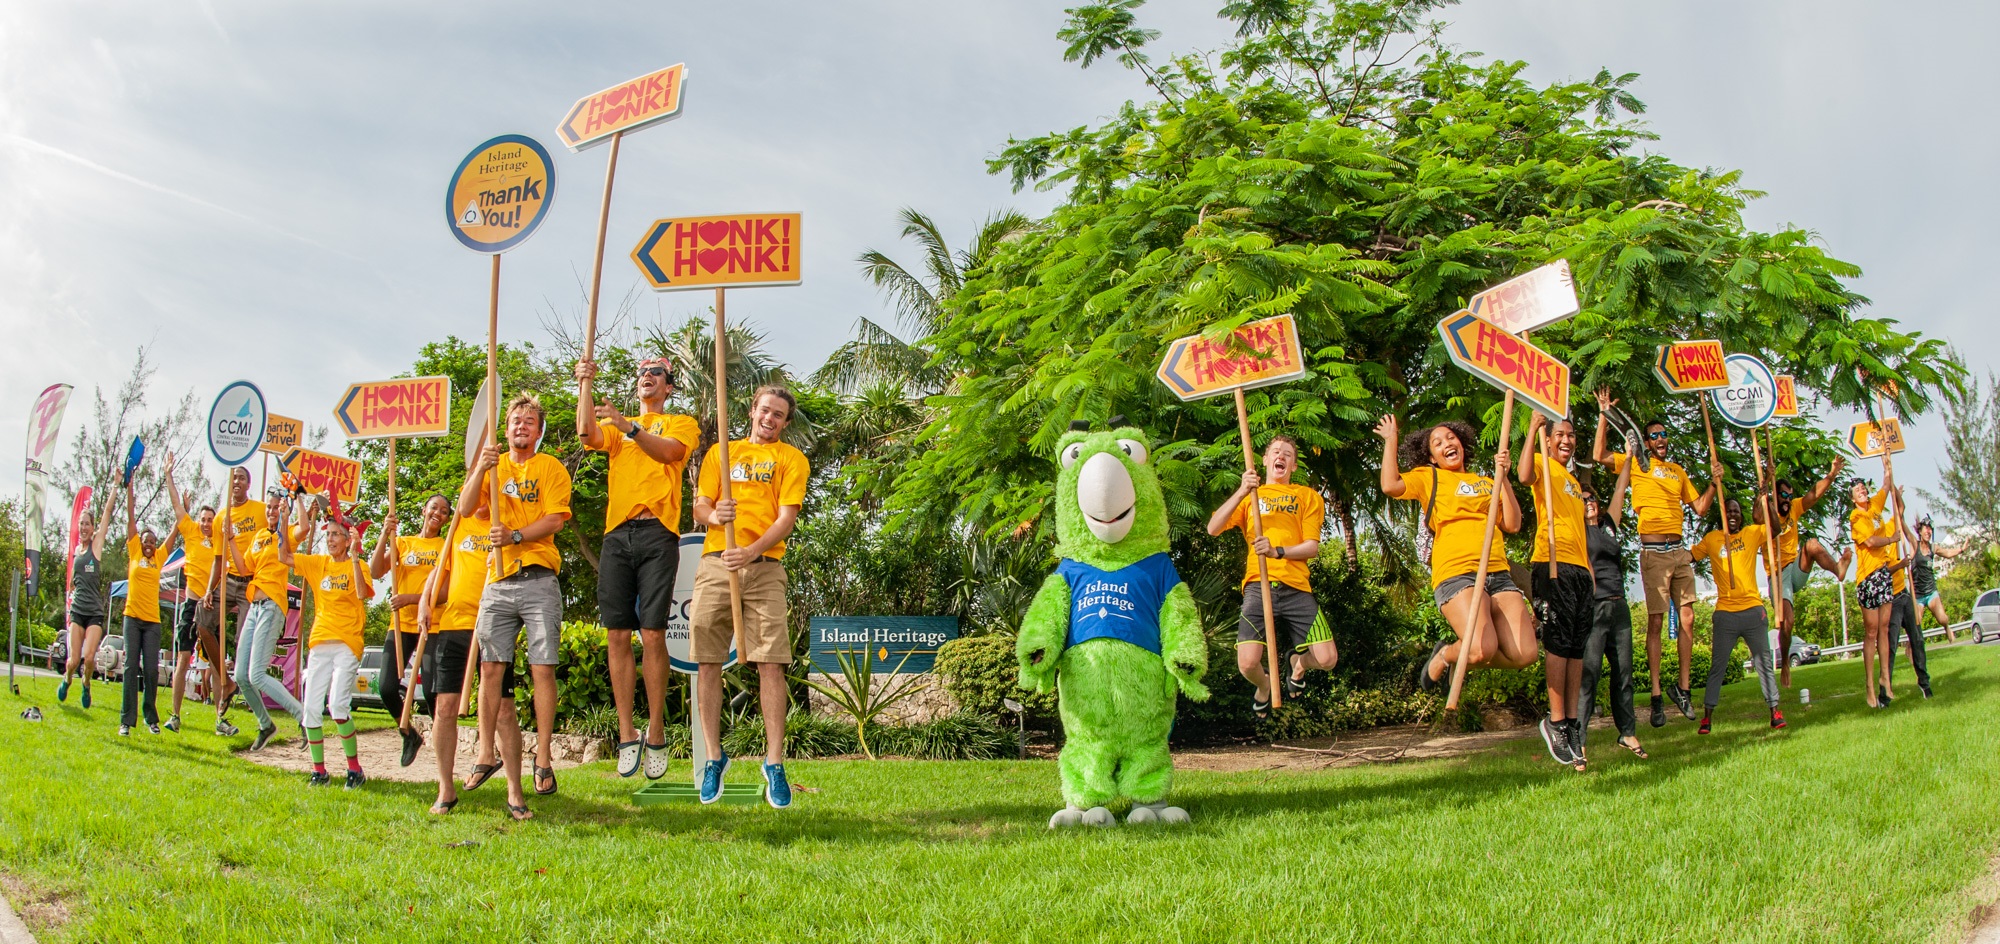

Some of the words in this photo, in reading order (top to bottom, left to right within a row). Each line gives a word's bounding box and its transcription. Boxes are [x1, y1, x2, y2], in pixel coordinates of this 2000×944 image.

[487, 147, 522, 163] Island
[478, 159, 528, 175] Heritage
[478, 176, 542, 208] Thank
[481, 205, 522, 229] You!
[1726, 386, 1763, 401] CCMI
[218, 419, 252, 436] CCMI
[266, 422, 296, 435] harity
[266, 433, 296, 446] Drive!
[743, 470, 775, 484] Drive!
[1261, 495, 1297, 504] Charity
[1265, 503, 1299, 515] Drive!
[470, 542, 494, 553] Drive
[415, 556, 437, 566] Drive
[1085, 580, 1128, 595] Island
[1077, 592, 1135, 612] Heritage
[668, 623, 690, 631] NTRAL
[666, 631, 690, 640] ARIN
[820, 627, 869, 643] Island
[873, 628, 947, 647] Heritage
